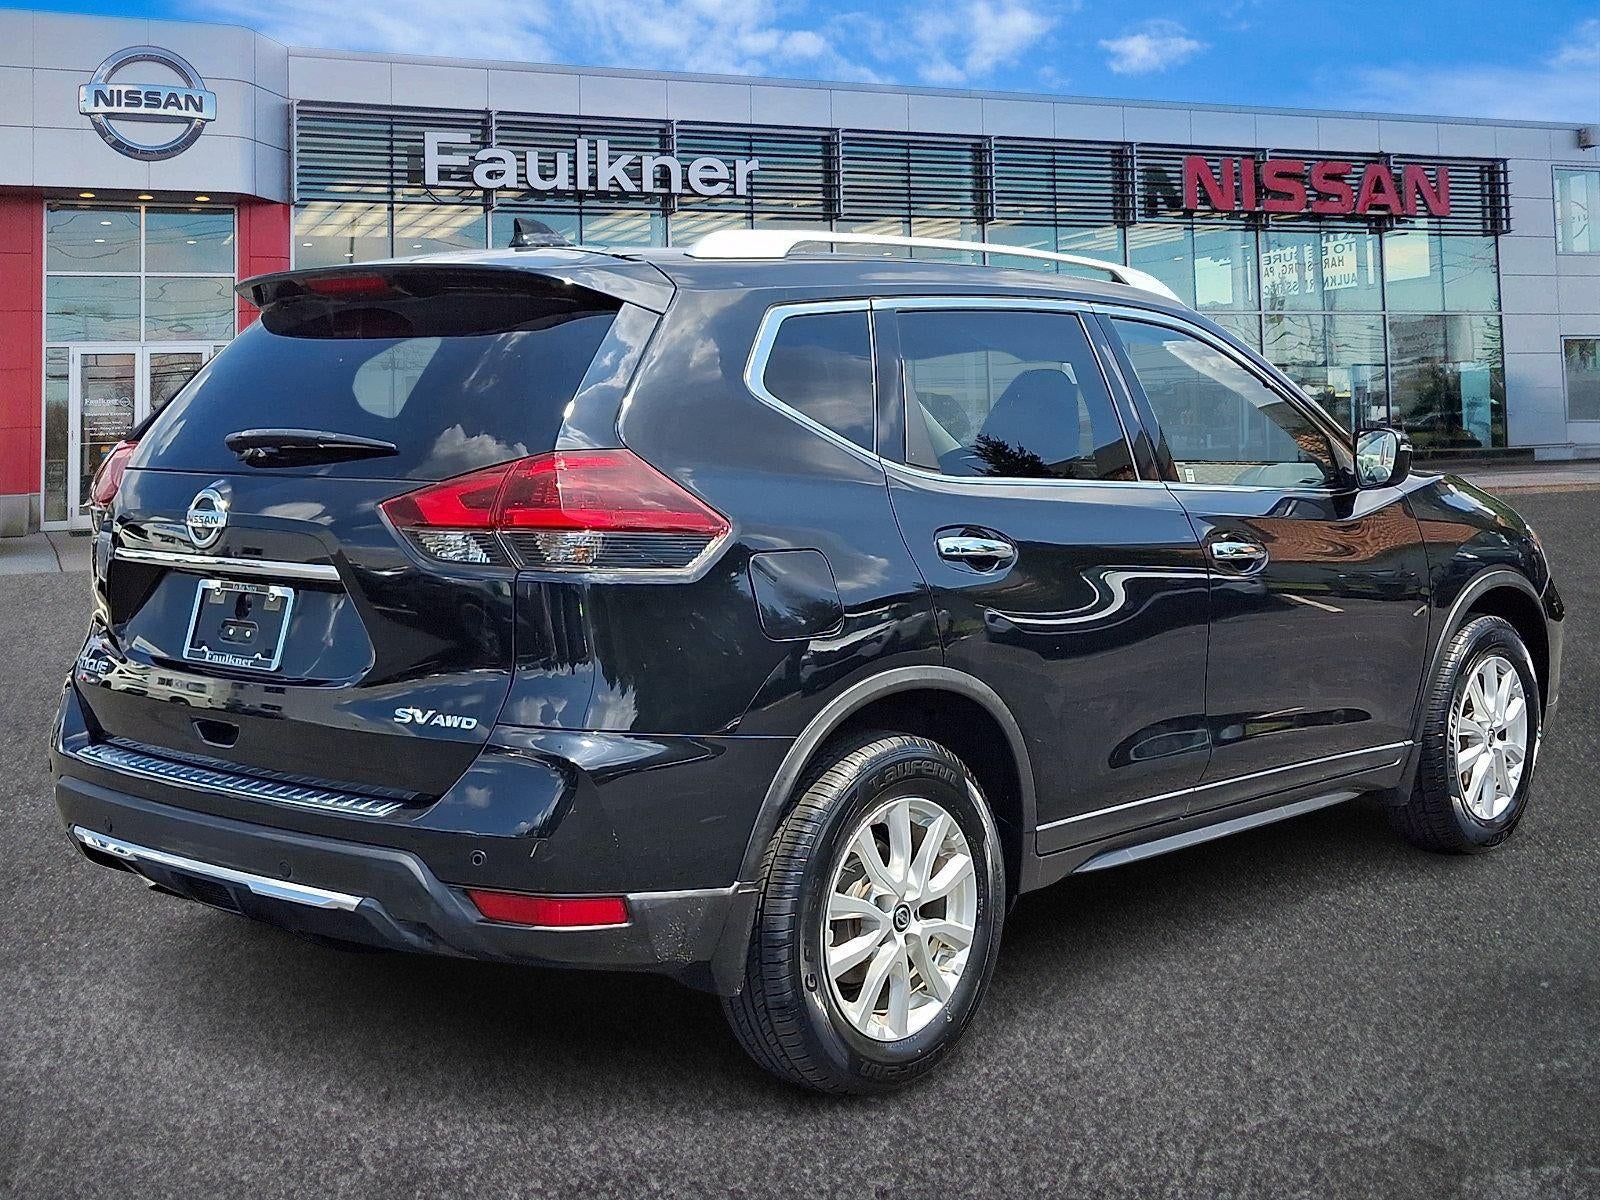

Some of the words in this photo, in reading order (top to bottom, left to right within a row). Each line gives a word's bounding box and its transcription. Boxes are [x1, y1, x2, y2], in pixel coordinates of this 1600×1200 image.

[94, 89, 203, 113] NISSAN
[423, 131, 760, 197] Faulkner
[1182, 154, 1451, 217] NISSAN
[205, 651, 255, 667] Faulkner
[393, 706, 437, 725] SV
[429, 714, 478, 730] AWD
